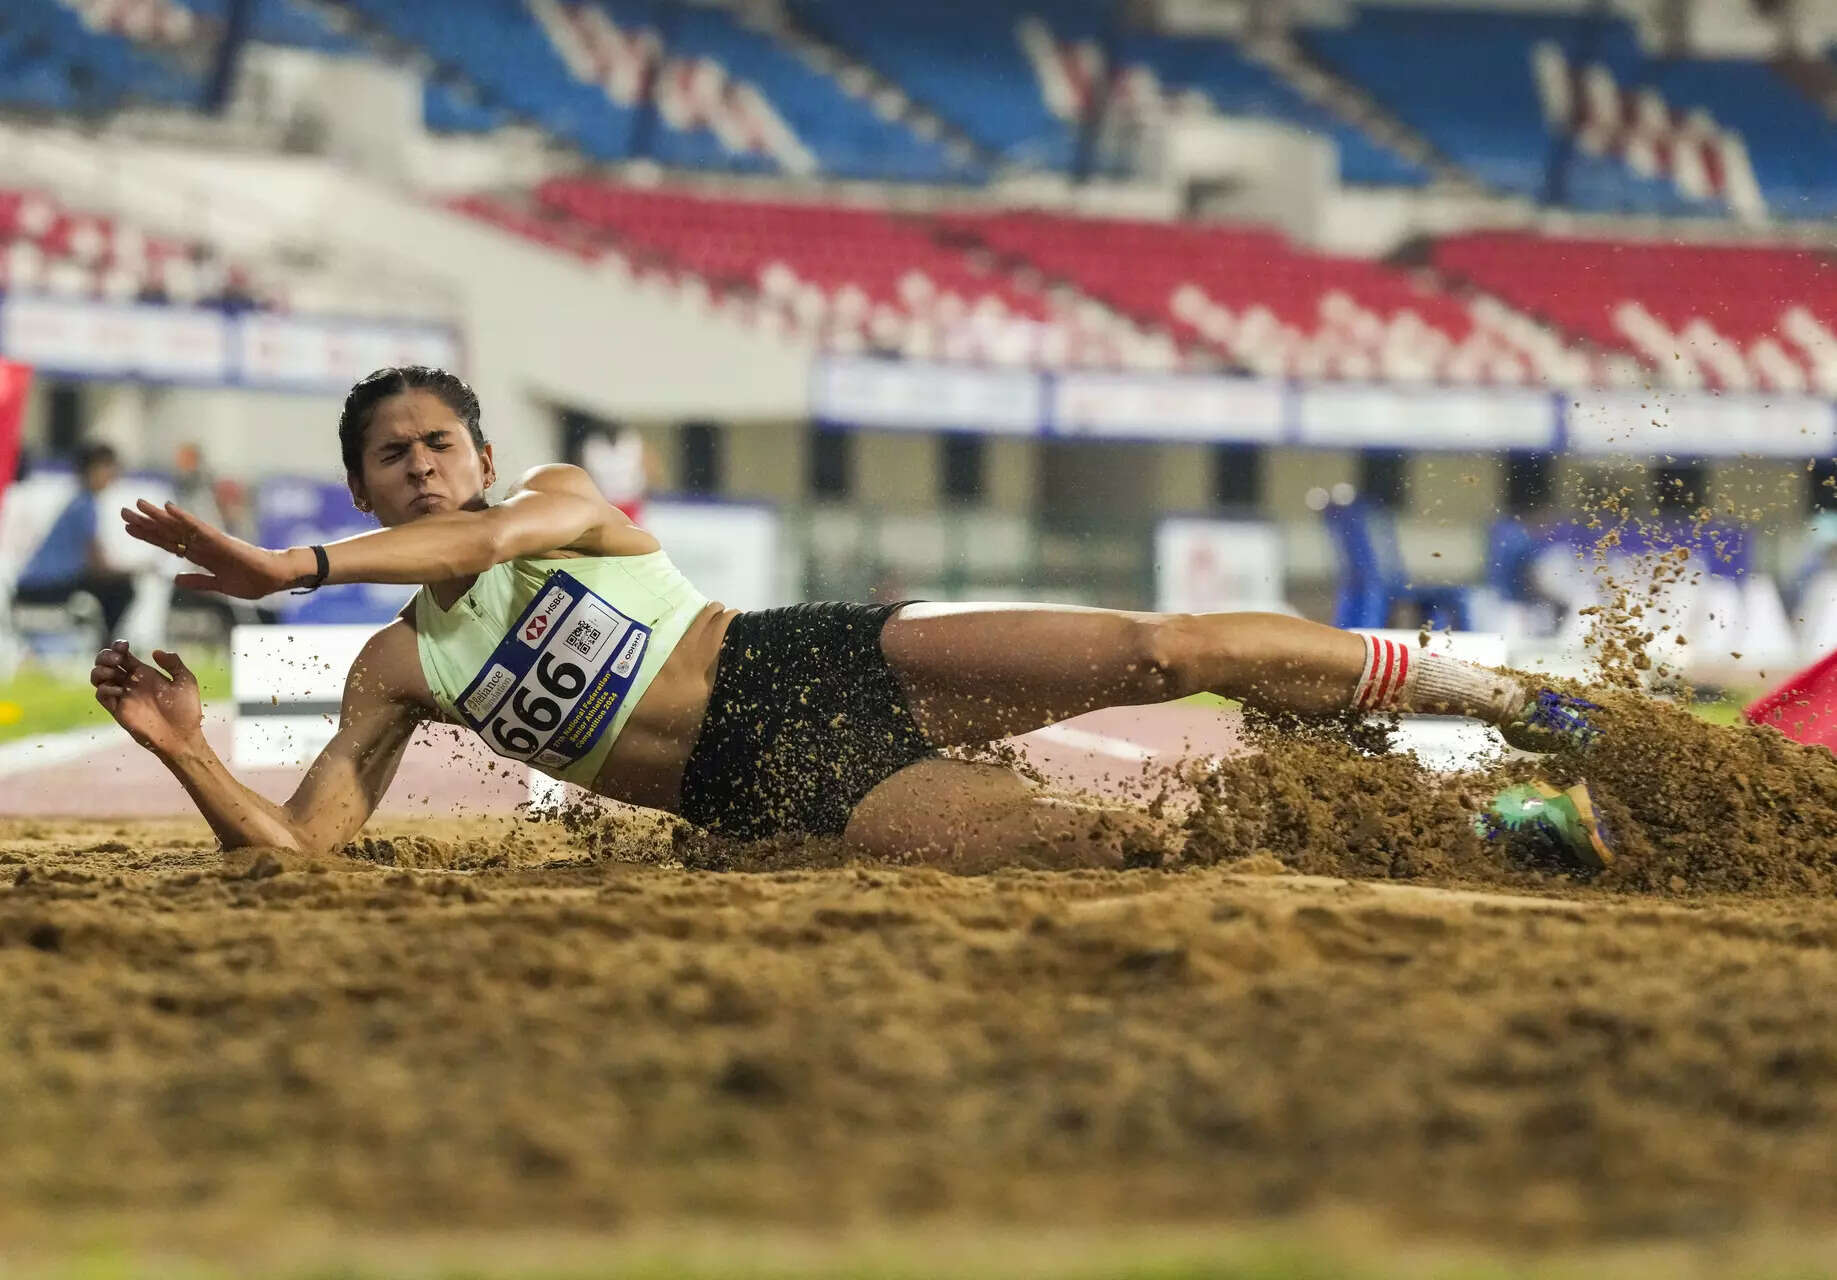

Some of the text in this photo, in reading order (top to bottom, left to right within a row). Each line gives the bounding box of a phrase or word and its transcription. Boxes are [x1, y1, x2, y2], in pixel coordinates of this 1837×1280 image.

[545, 592, 565, 615] HSBC
[625, 632, 642, 660] ODISHA
[472, 671, 504, 706] Reliance
[491, 651, 587, 754] 666
[563, 708, 585, 737] National
[582, 673, 611, 709] Federation
[569, 691, 609, 742] Senior Athletics
[576, 710, 606, 749] Competition
